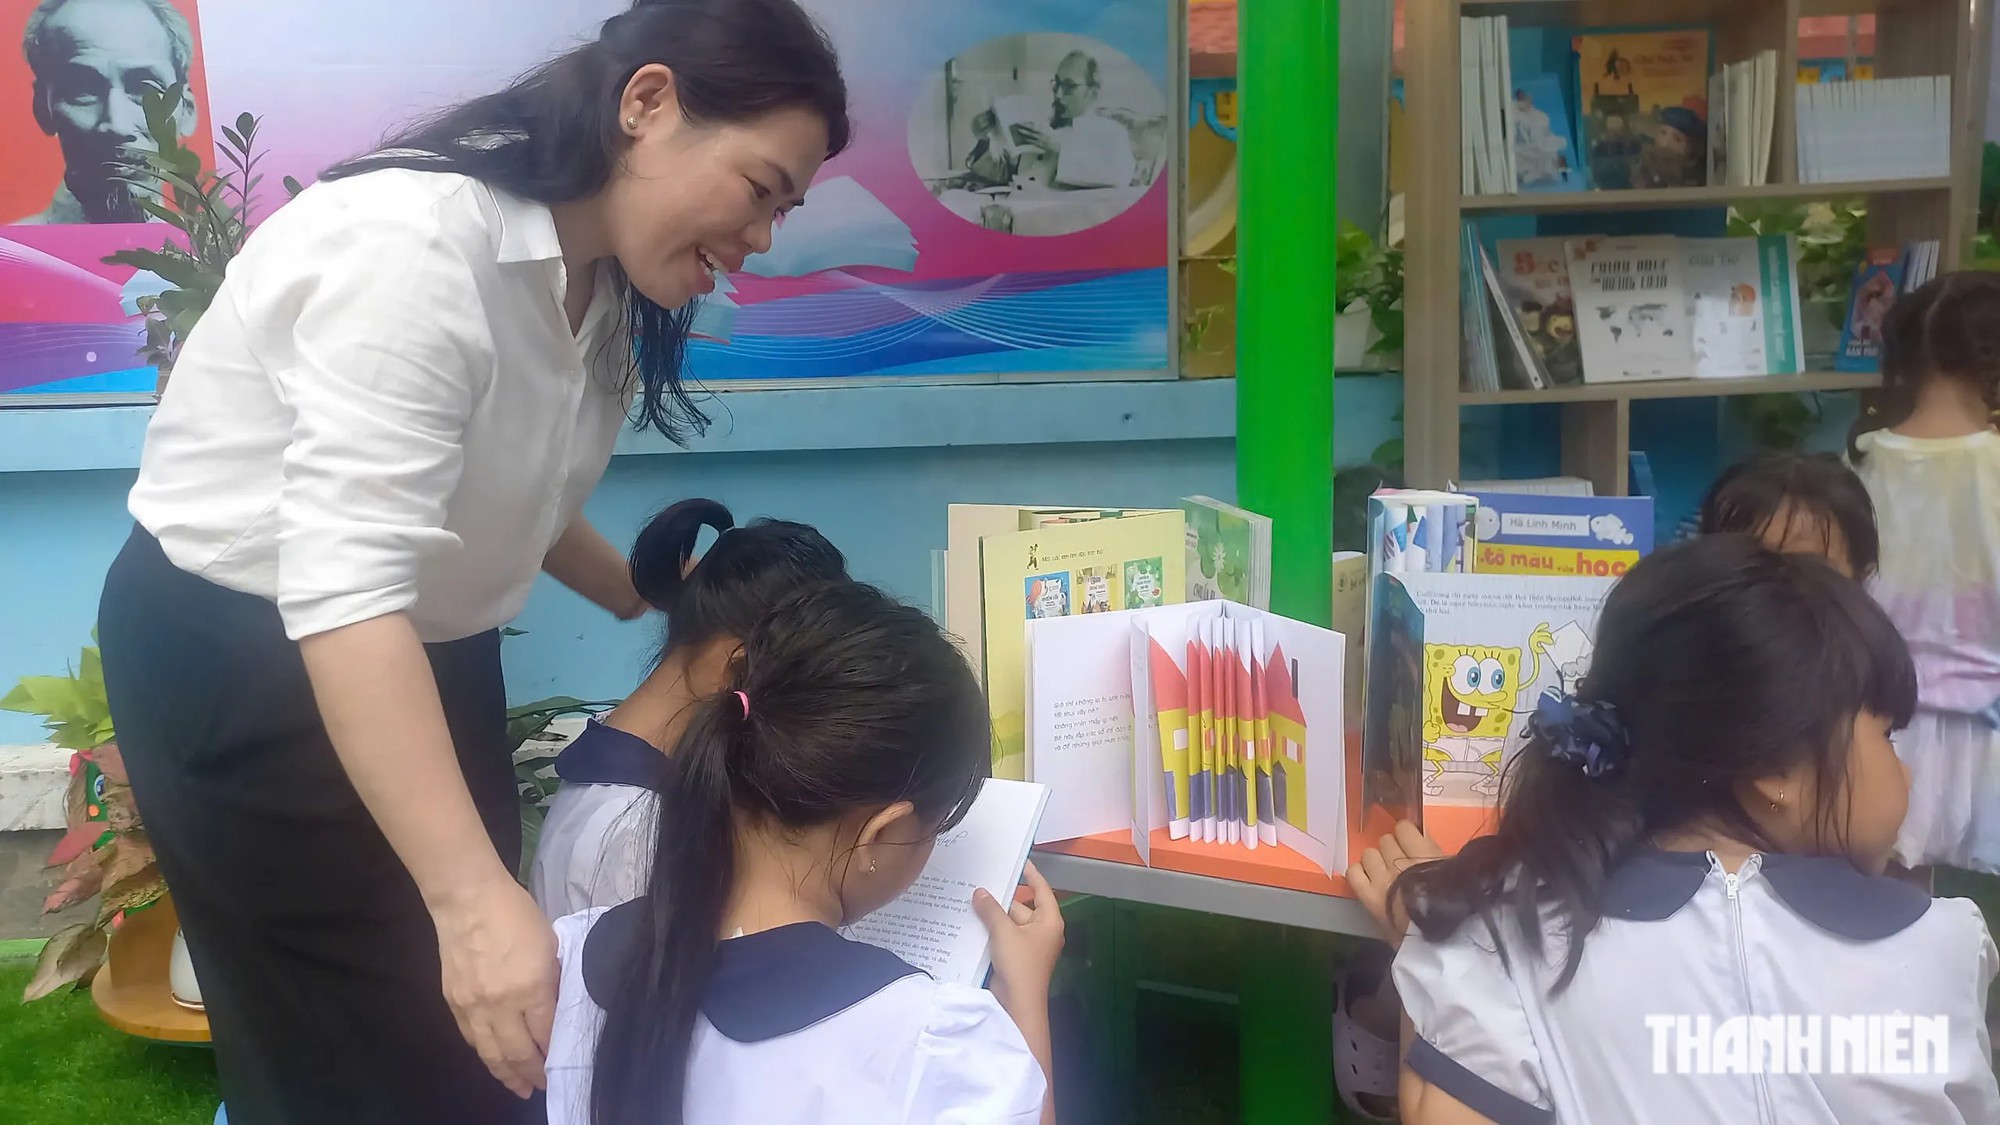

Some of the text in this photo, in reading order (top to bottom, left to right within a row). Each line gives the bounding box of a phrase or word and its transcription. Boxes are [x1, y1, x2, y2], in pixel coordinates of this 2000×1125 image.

[1510, 518, 1577, 531] Hà Linh Minh
[1485, 547, 1505, 566] tô
